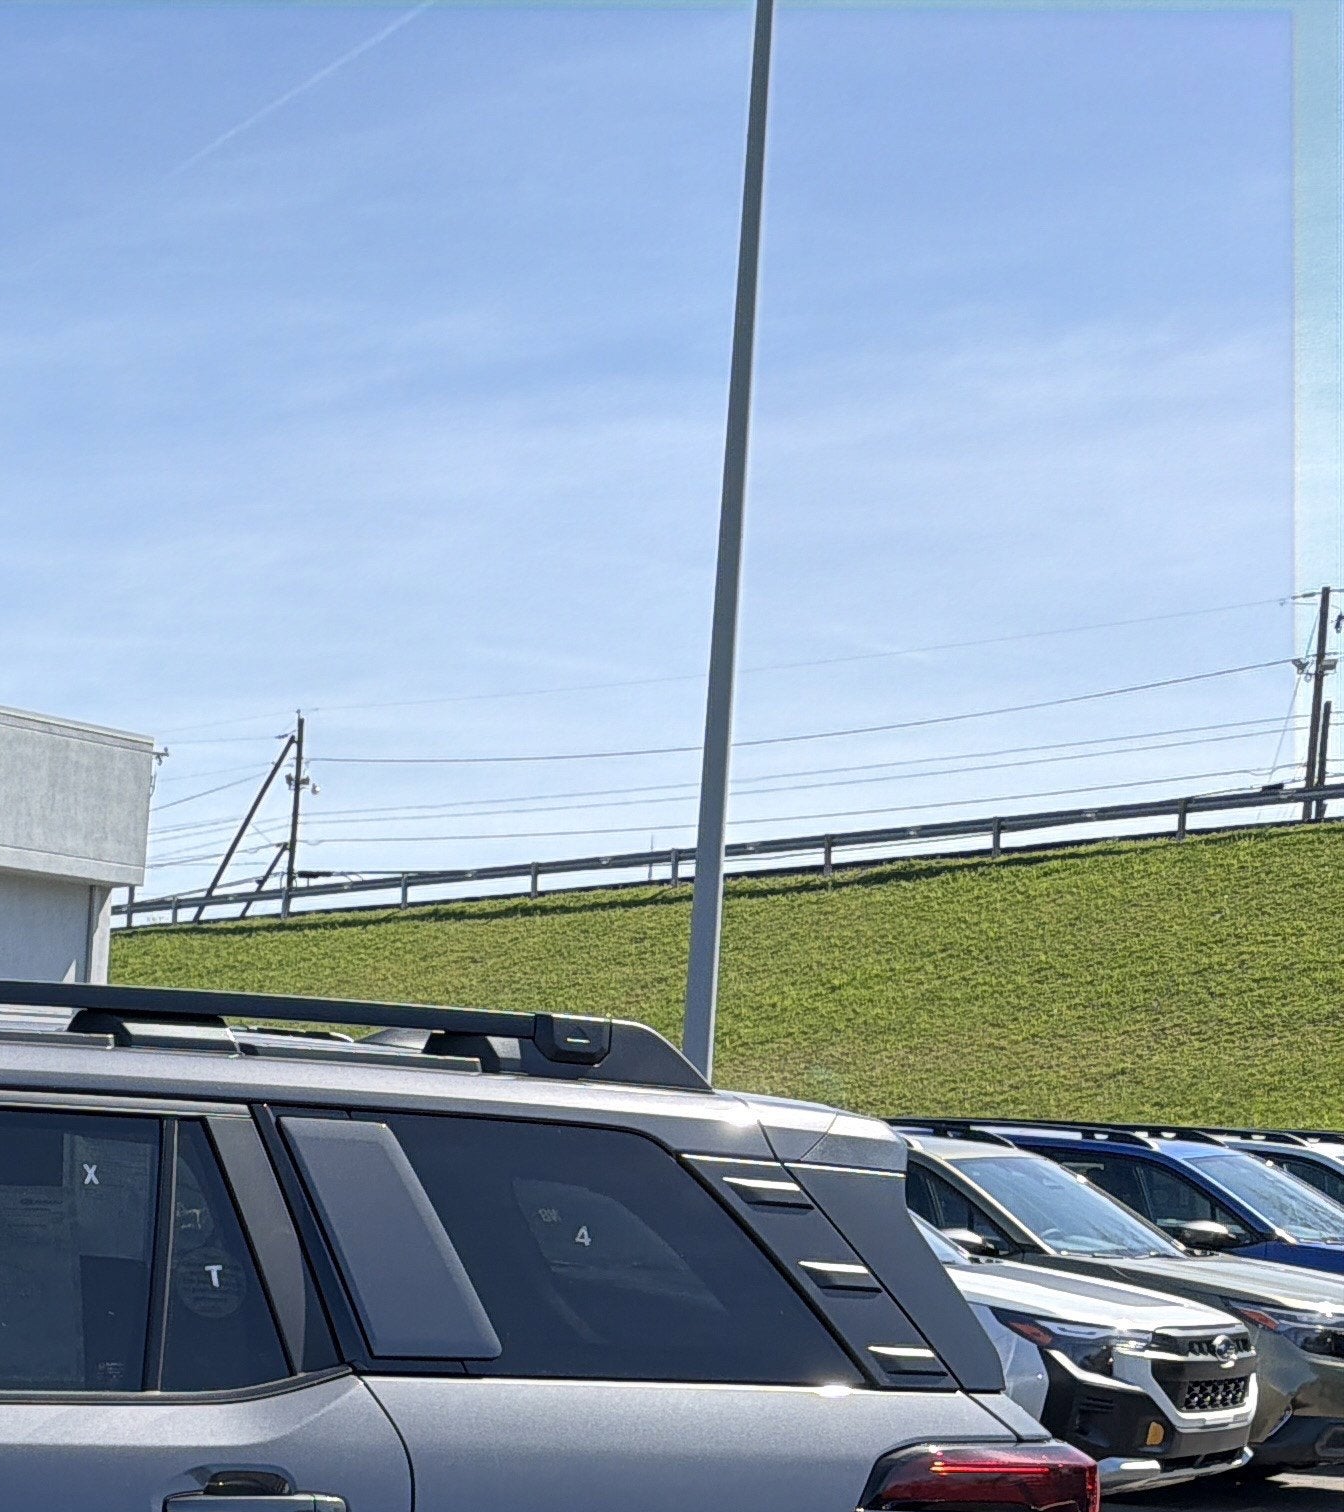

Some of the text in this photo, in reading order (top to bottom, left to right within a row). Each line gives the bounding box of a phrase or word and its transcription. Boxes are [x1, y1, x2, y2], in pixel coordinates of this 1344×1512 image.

[81, 1163, 100, 1185] X
[574, 1225, 592, 1247] 4
[204, 1264, 223, 1288] T
